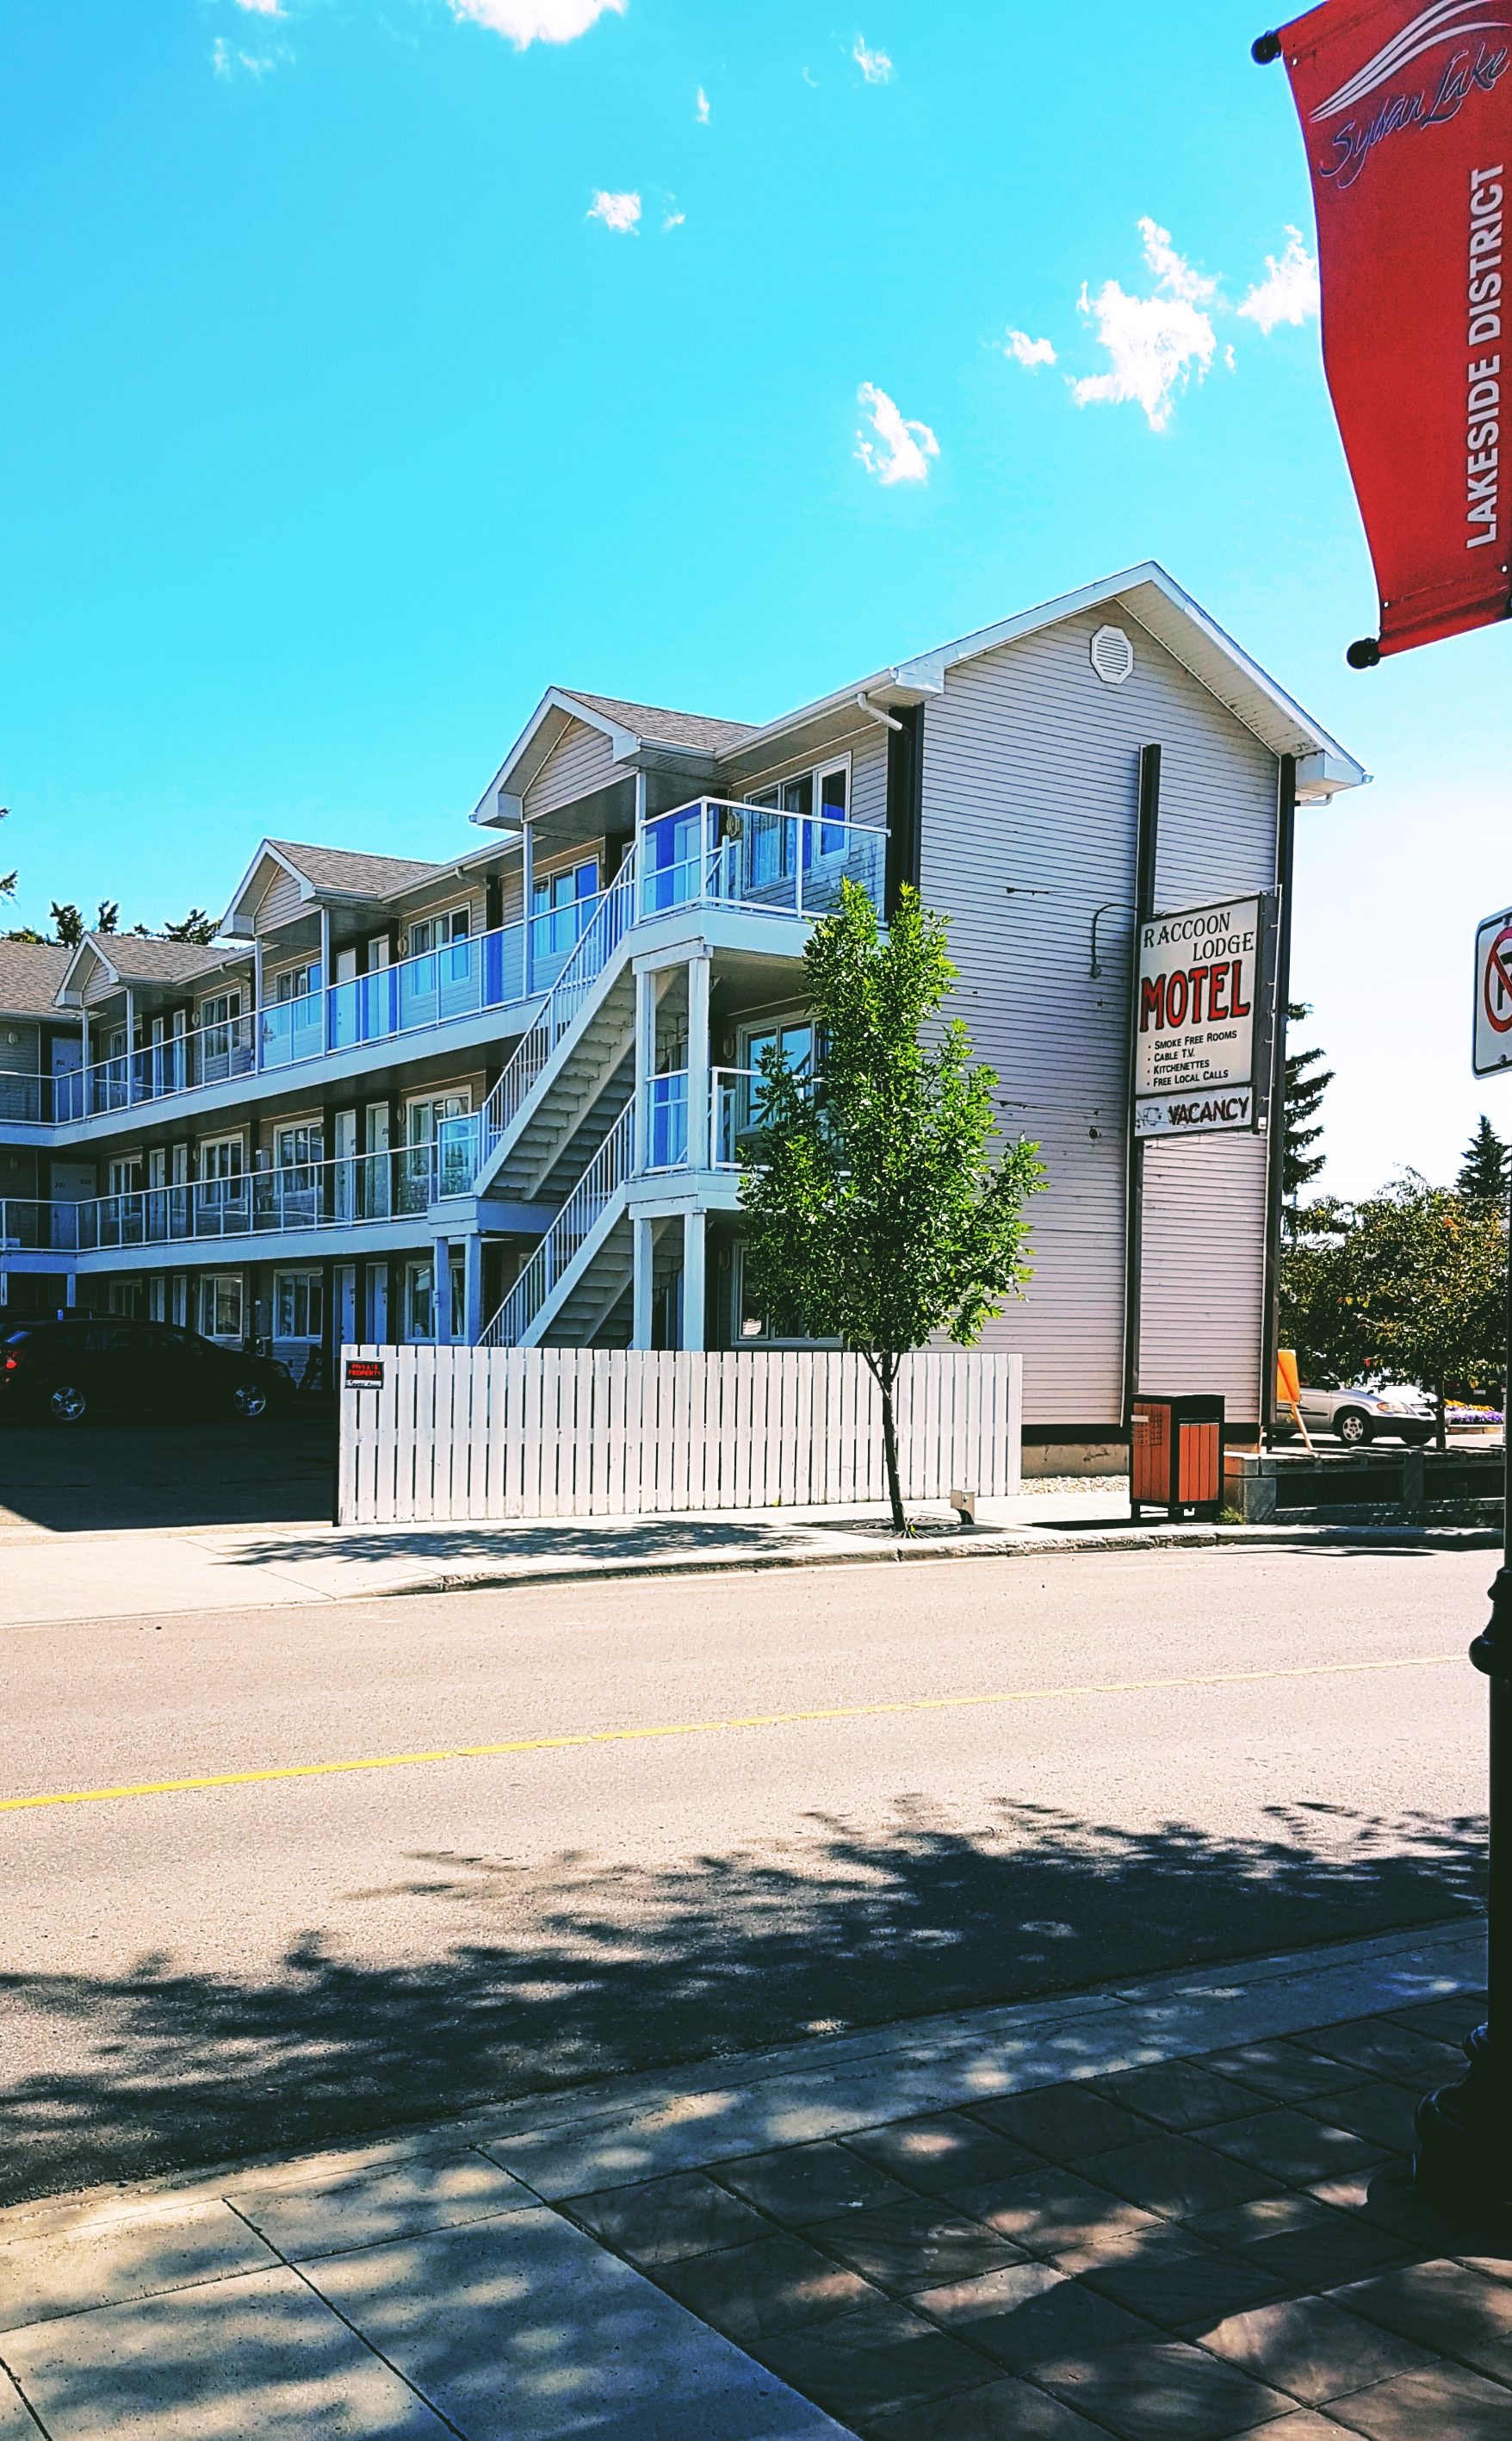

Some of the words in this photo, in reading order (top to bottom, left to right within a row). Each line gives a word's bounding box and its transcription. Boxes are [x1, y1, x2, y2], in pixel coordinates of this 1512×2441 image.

[1319, 90, 1426, 189] Sylvan
[1421, 41, 1511, 130] Lake
[1468, 164, 1504, 346] DISTRICT
[1466, 354, 1500, 549] LAKESIDE
[1143, 911, 1231, 948] RACCOON
[1193, 931, 1255, 962] LODGE
[1139, 959, 1251, 1033] MOTEL
[1154, 1038, 1182, 1050] SMOKE
[1184, 1035, 1204, 1047] FREE
[1206, 1029, 1237, 1043] ROOMS
[1153, 1059, 1210, 1075] KITCHENETTES
[1154, 1051, 1179, 1063] CABLE
[1153, 1077, 1172, 1087] FREE
[1174, 1073, 1200, 1084] LOCAL
[1203, 1069, 1229, 1081] CALLS
[1167, 1096, 1249, 1126] VACANCY
